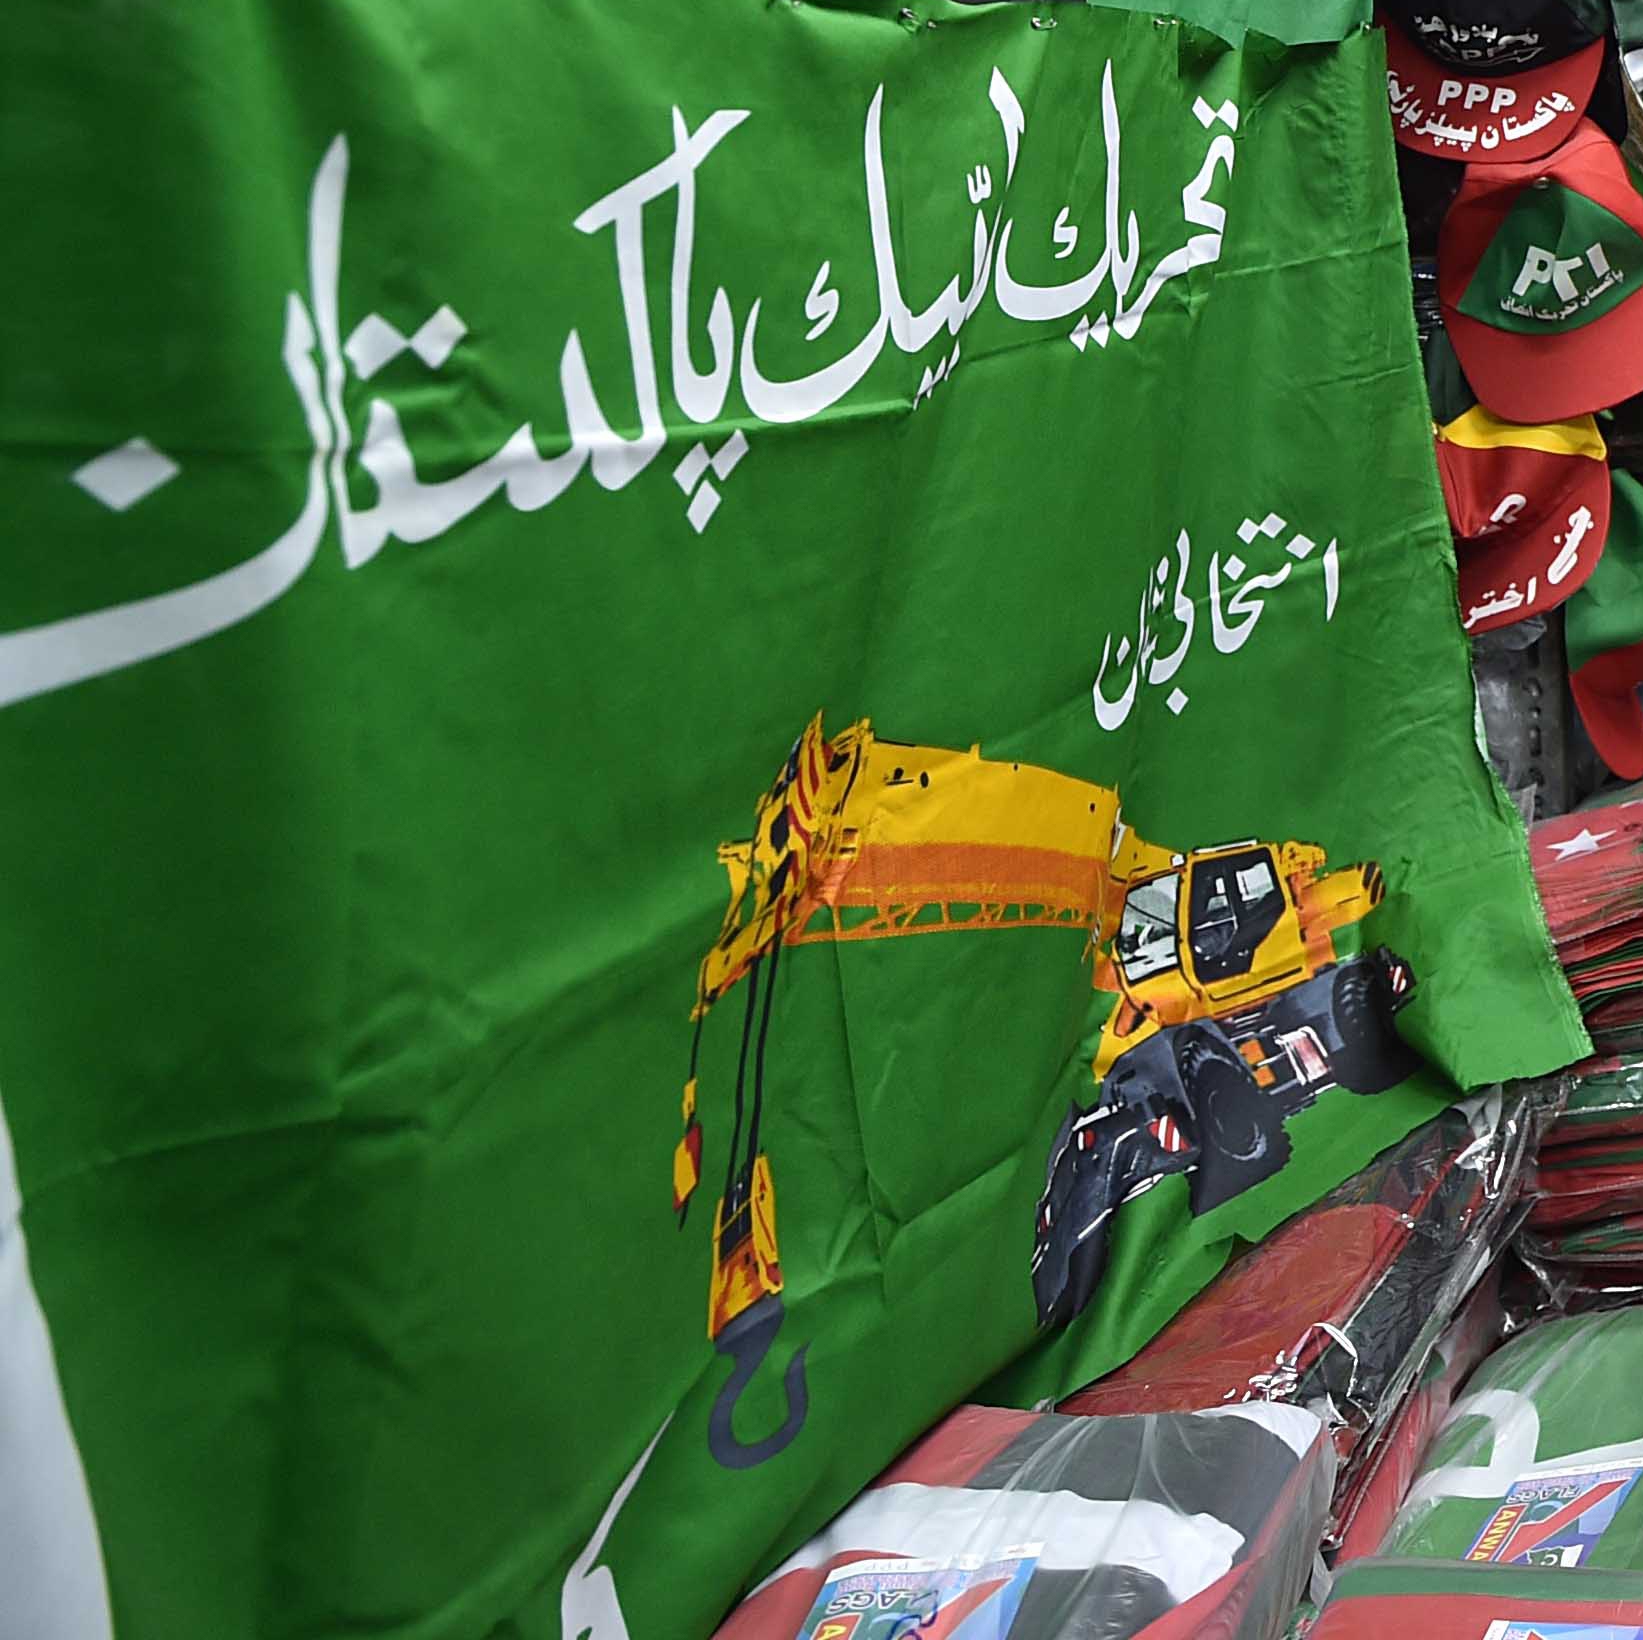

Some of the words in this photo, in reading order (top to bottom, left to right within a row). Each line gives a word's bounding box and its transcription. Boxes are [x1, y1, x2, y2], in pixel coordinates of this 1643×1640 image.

[1437, 79, 1518, 115] PPP
[1480, 91, 1577, 150] پاکستان
[1511, 241, 1611, 303] PTI
[0, 103, 751, 709] پاکستان
[1147, 511, 1340, 717] انتخابی
[1472, 1509, 1519, 1561] ANWA
